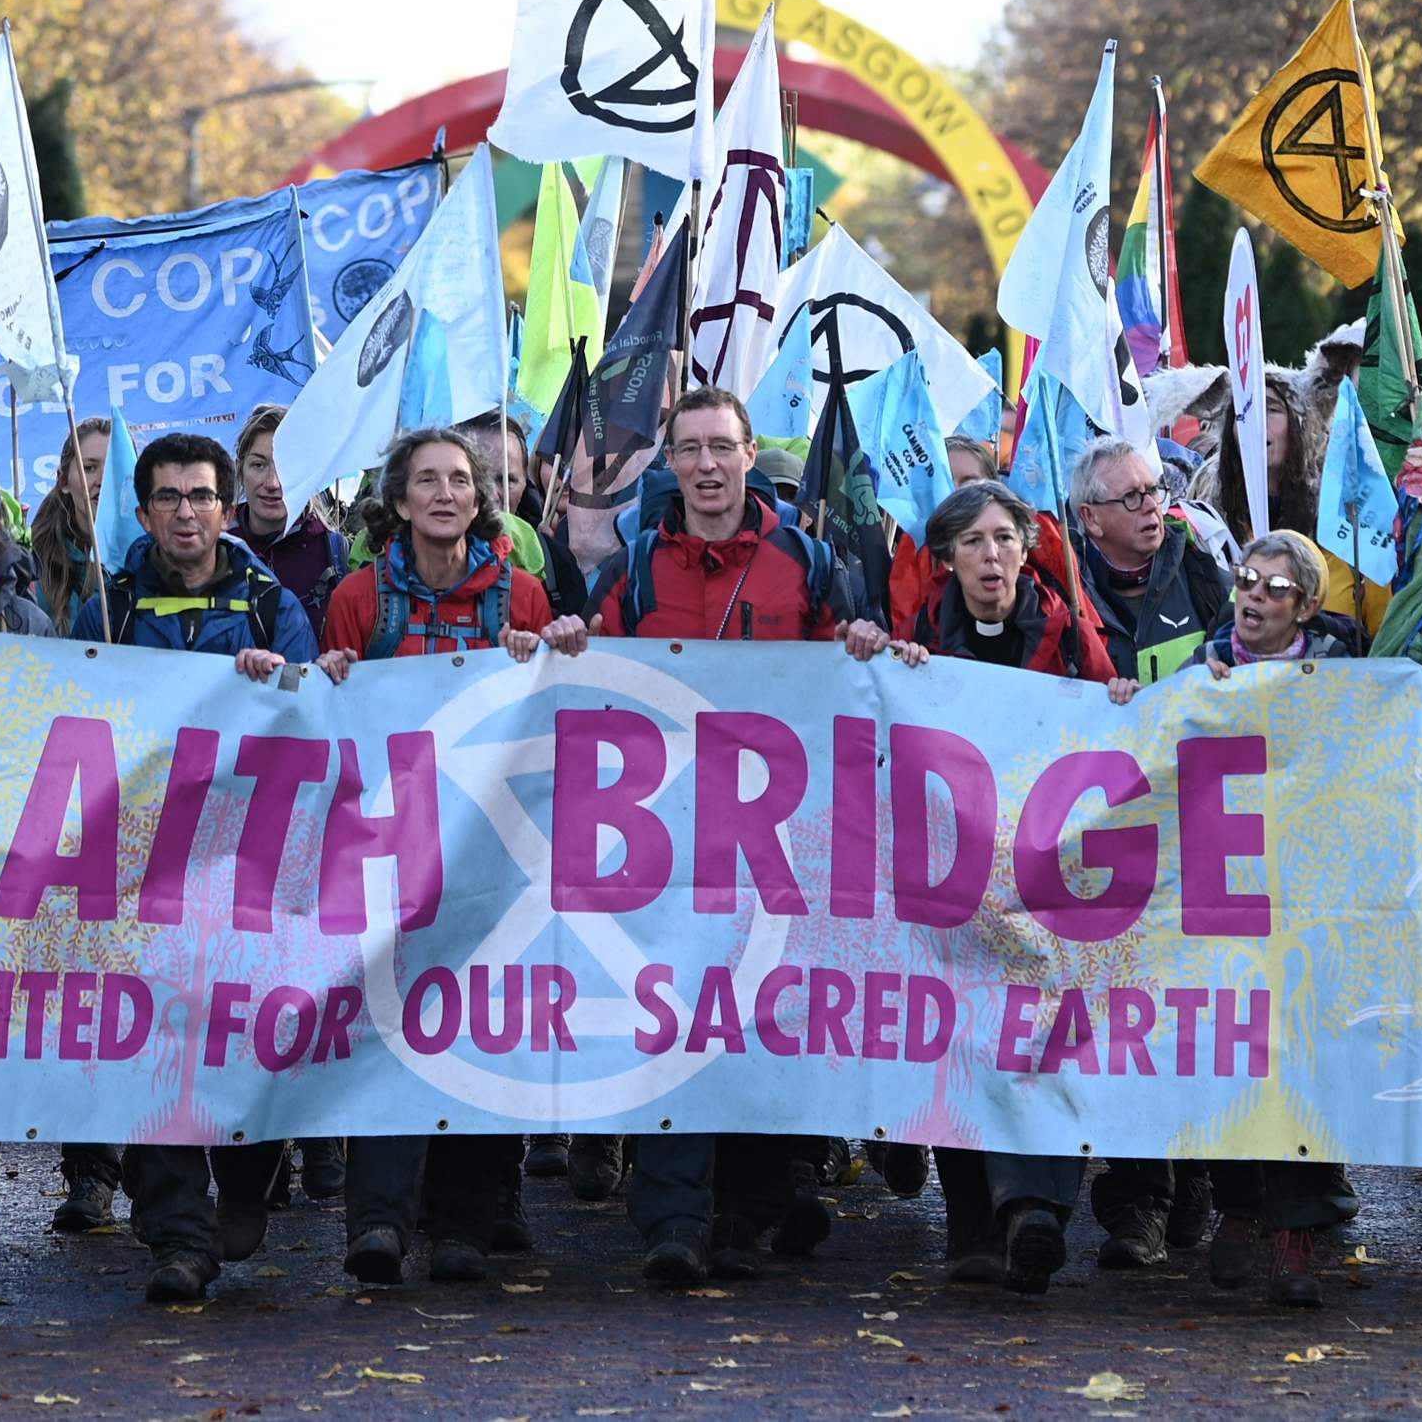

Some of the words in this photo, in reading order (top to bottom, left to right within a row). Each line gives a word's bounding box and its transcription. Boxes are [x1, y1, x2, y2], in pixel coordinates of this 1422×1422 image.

[311, 174, 429, 252] COP
[91, 246, 264, 319] COP
[107, 353, 233, 407] FOR
[587, 397, 604, 440] justice
[902, 423, 929, 464] CAMINO
[924, 462, 935, 478] TO
[902, 449, 915, 469] COP
[550, 708, 1273, 943] BRIDGE
[202, 981, 364, 1074] FOR
[401, 964, 578, 1056] OUR
[634, 963, 957, 1064] SACRED
[995, 983, 1271, 1078] EARTH
